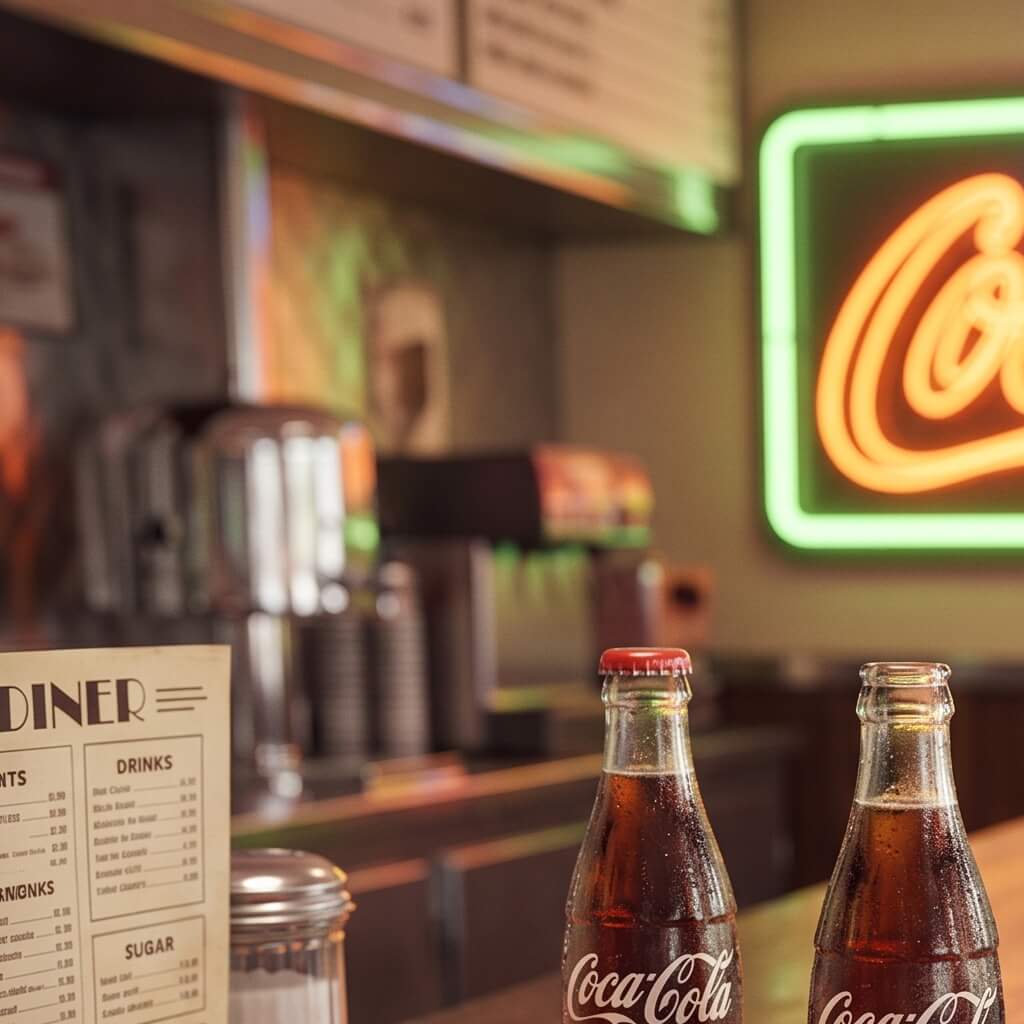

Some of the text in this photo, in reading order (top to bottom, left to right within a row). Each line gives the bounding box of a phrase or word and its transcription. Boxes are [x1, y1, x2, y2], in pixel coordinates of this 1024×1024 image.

[0, 678, 146, 732] DINER
[117, 755, 173, 775] DRINKS
[125, 936, 174, 960] SUGAR
